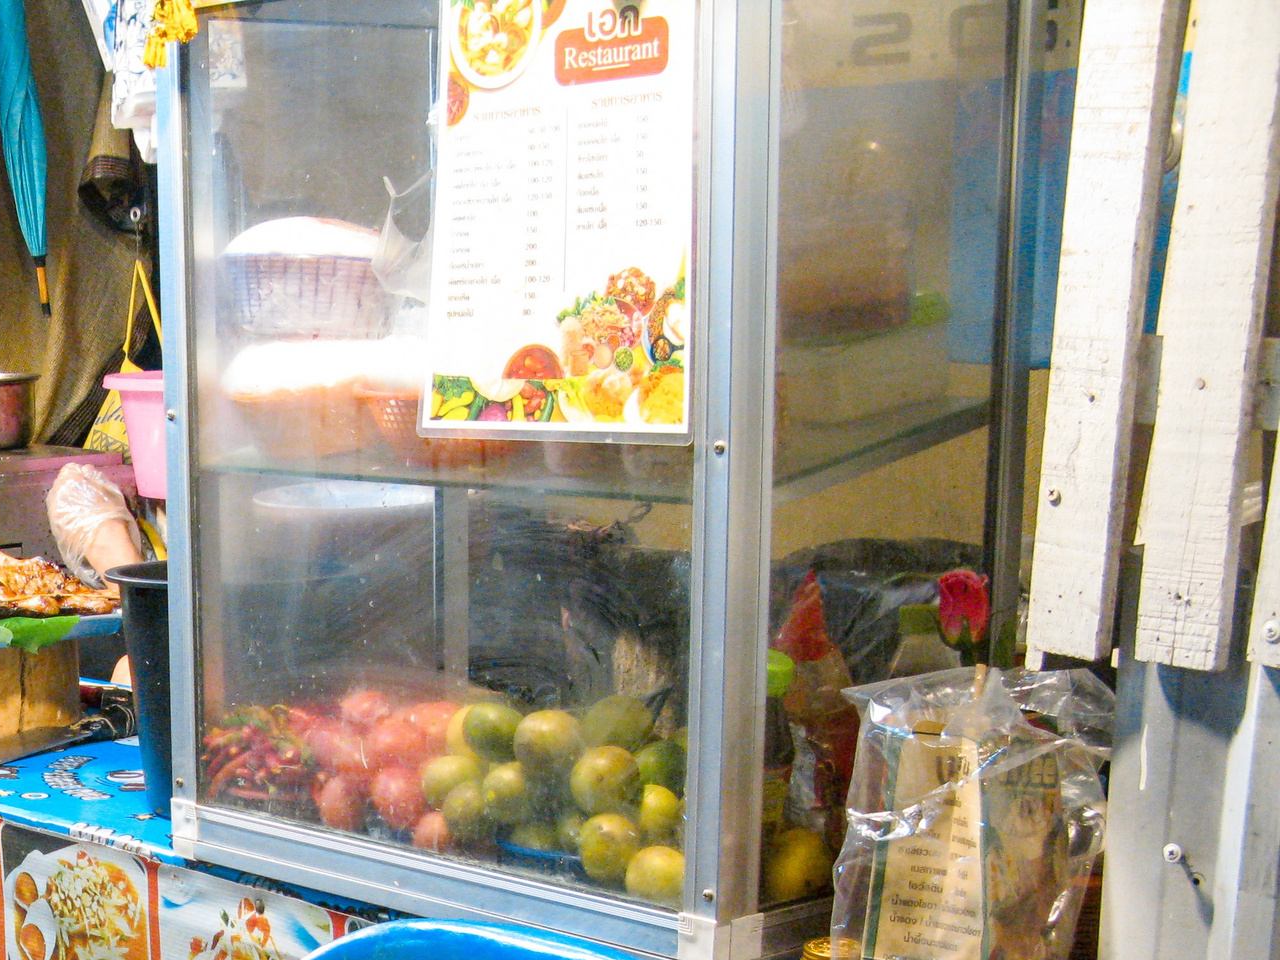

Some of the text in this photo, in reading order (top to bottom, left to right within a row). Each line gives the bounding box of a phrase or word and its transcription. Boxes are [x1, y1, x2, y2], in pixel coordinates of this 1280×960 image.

[585, 4, 641, 41] เอก
[564, 37, 659, 69] Restaurant
[592, 91, 662, 109] รายการอาหาร
[473, 106, 541, 122] รายการอาหาร
